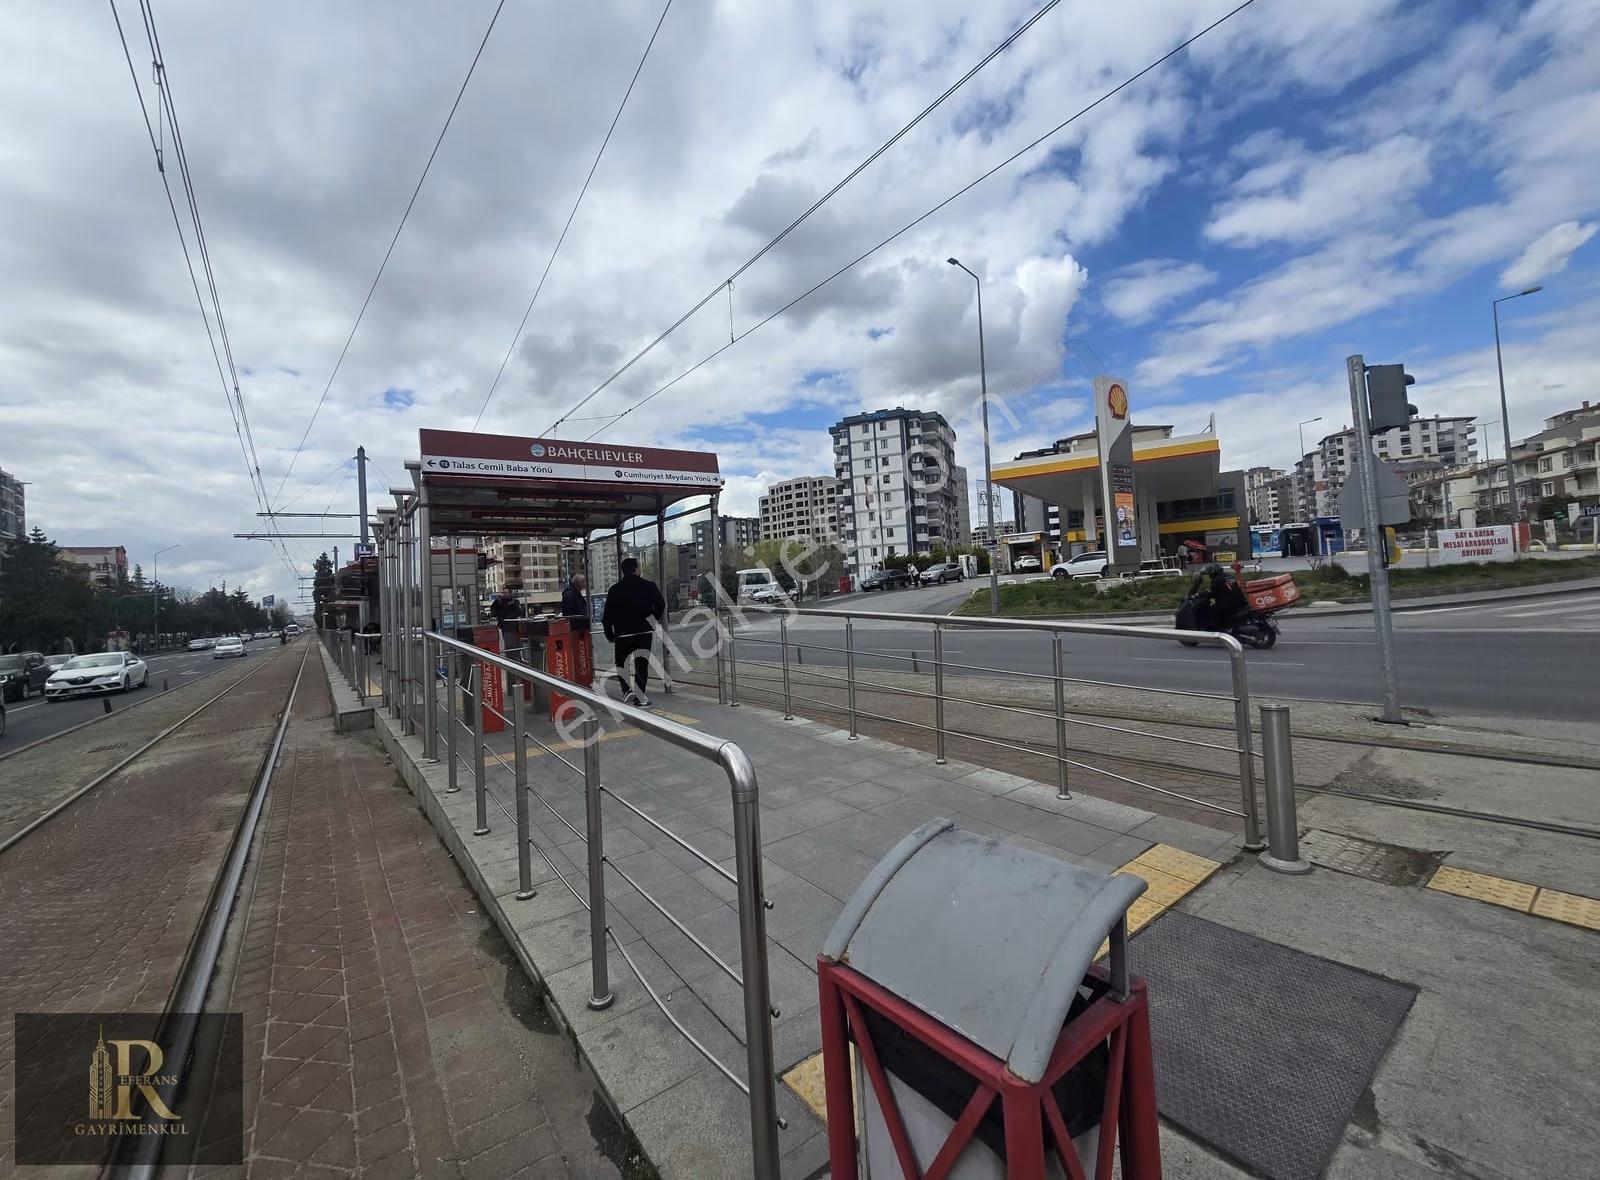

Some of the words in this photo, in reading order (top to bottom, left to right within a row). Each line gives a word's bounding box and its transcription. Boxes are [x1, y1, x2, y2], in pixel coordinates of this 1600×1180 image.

[452, 461, 475, 469] Talas
[478, 462, 504, 471] Cemil
[507, 464, 529, 473] Baba
[531, 465, 553, 474] Yönü
[623, 471, 664, 480] Cumhuriyet
[665, 474, 694, 482] Meydanı
[1474, 530, 1494, 538] BAYAN
[1462, 548, 1493, 557] ARIYORUZ
